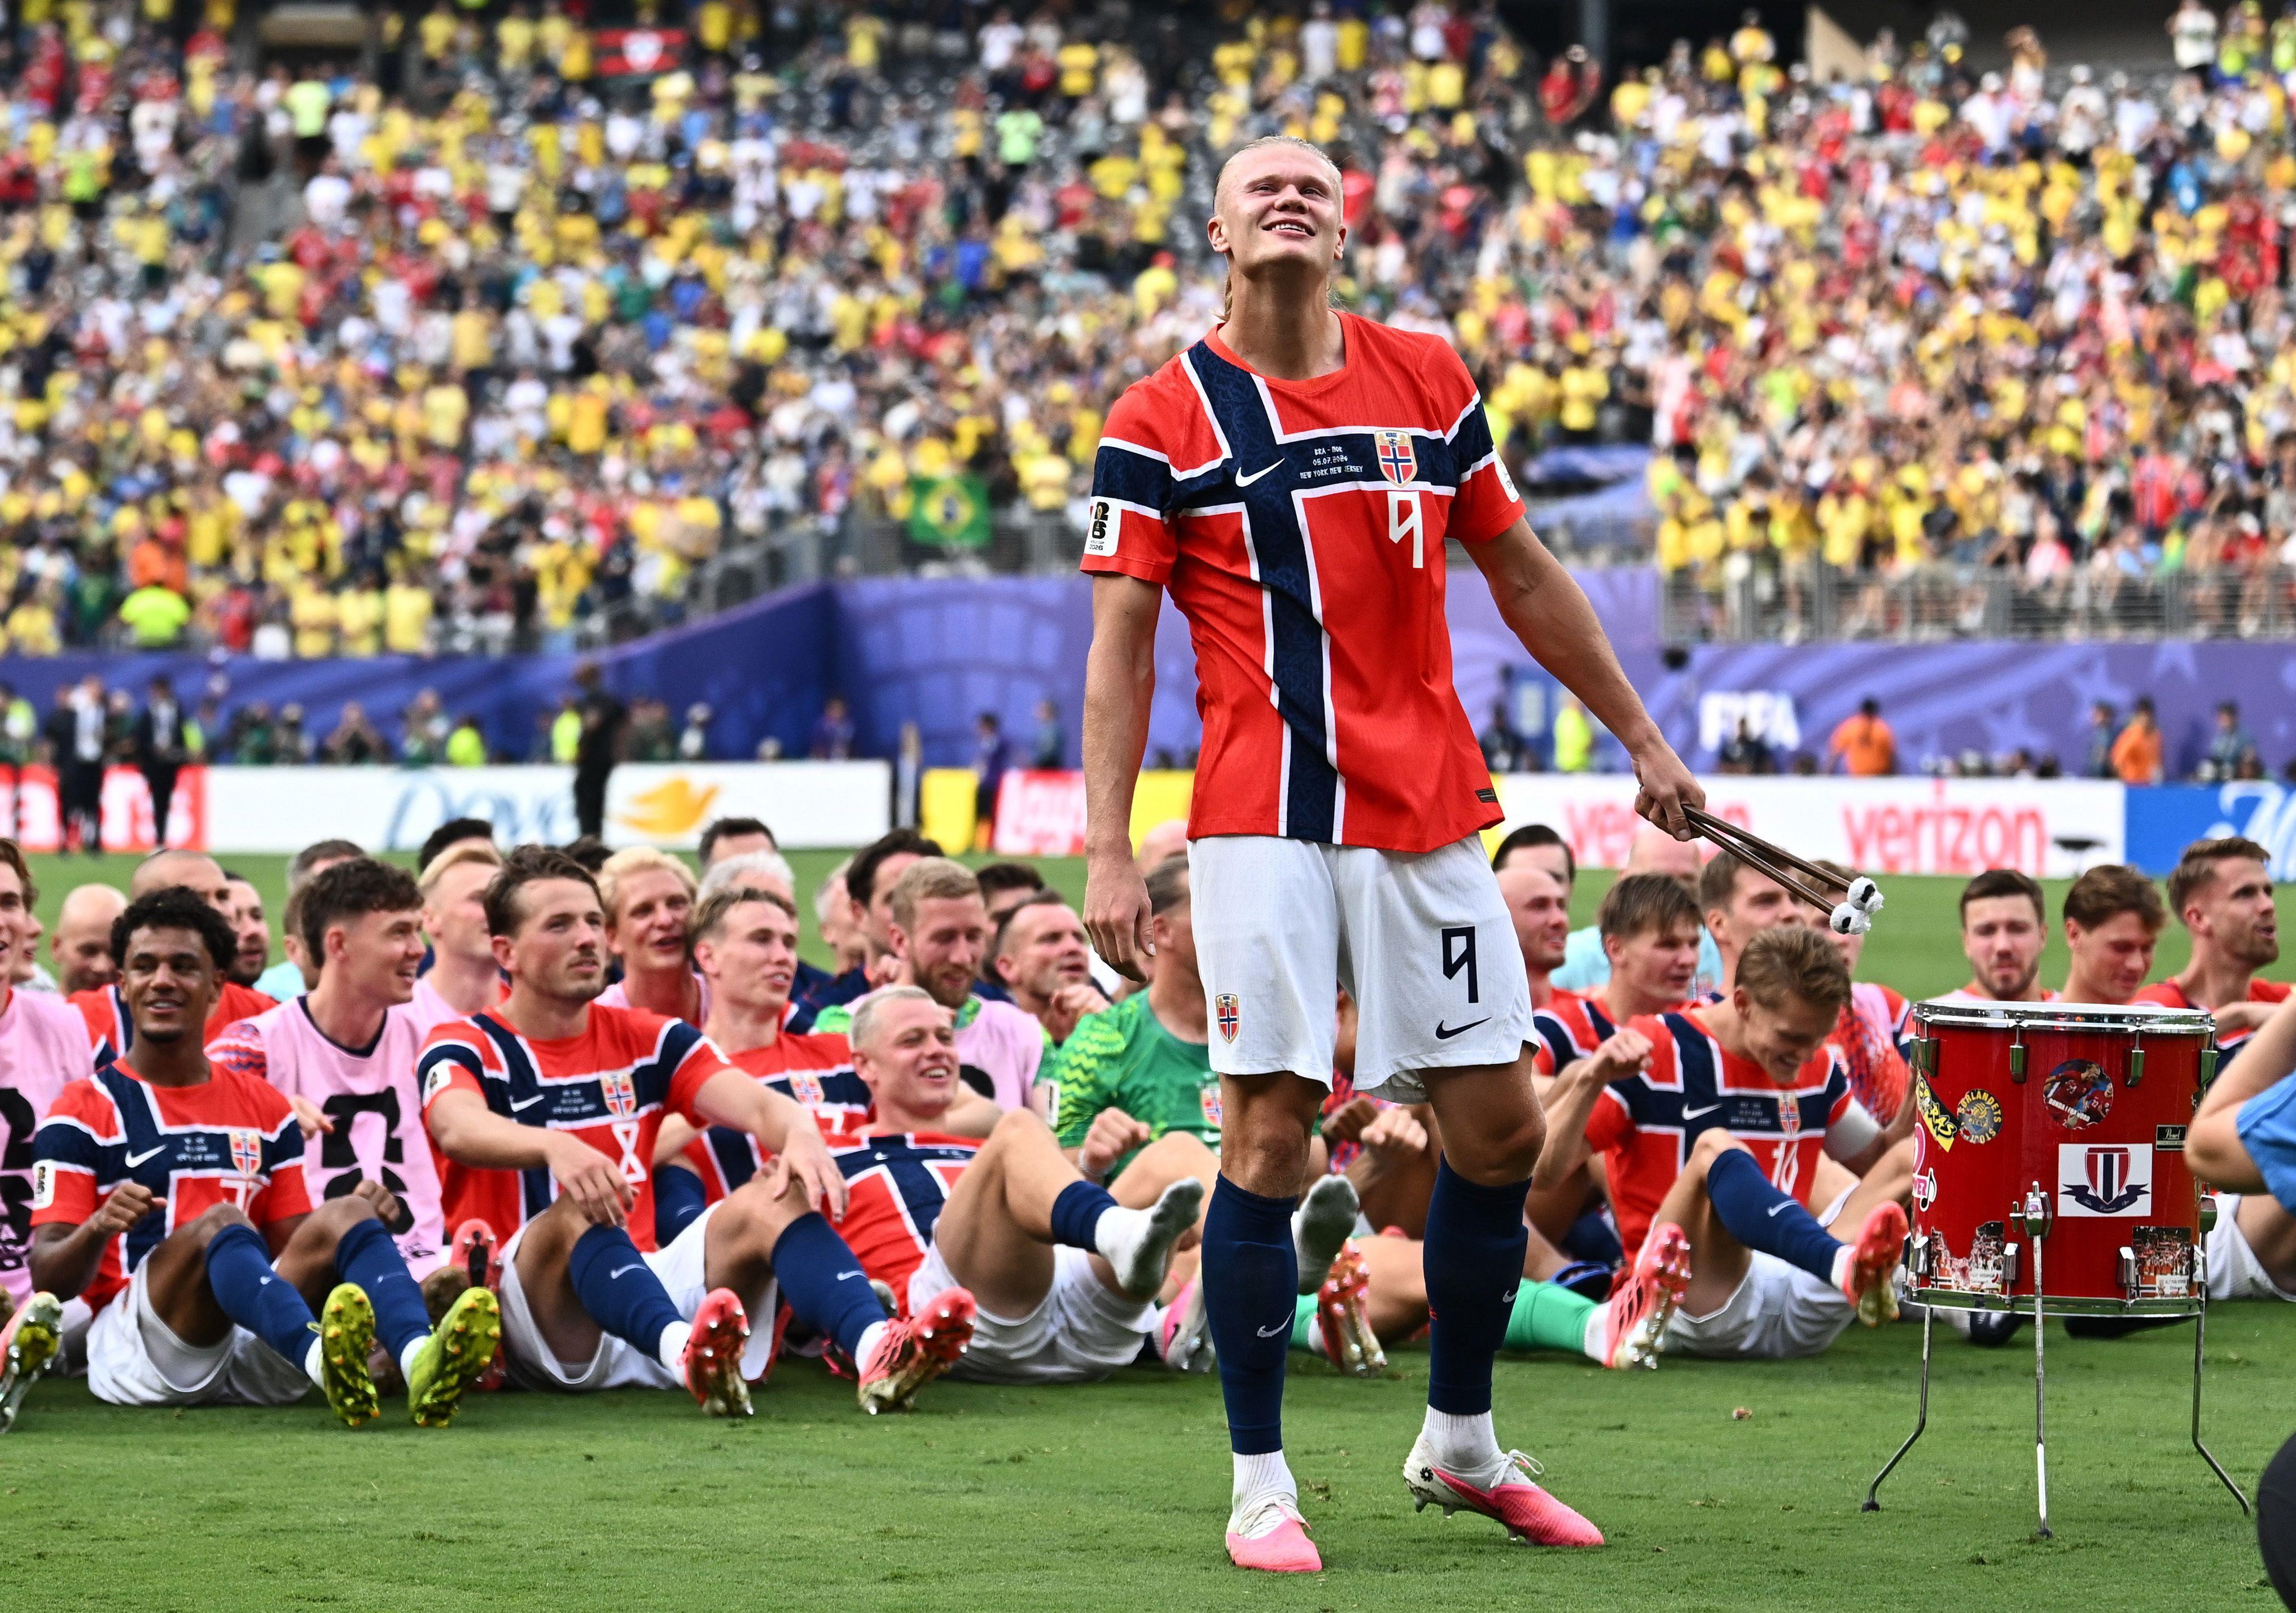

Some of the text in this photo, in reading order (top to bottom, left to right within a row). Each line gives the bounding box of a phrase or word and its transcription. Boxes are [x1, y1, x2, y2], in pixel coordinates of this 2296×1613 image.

[1299, 464, 1363, 480] NEW YORK NEW JERSEY
[1313, 455, 1348, 466] 05.07.2026
[1314, 446, 1326, 456] BRA
[1388, 491, 1423, 568] 9
[1843, 779, 2048, 877] verizon
[1441, 926, 1479, 1003] 9
[612, 1120, 647, 1184] 8
